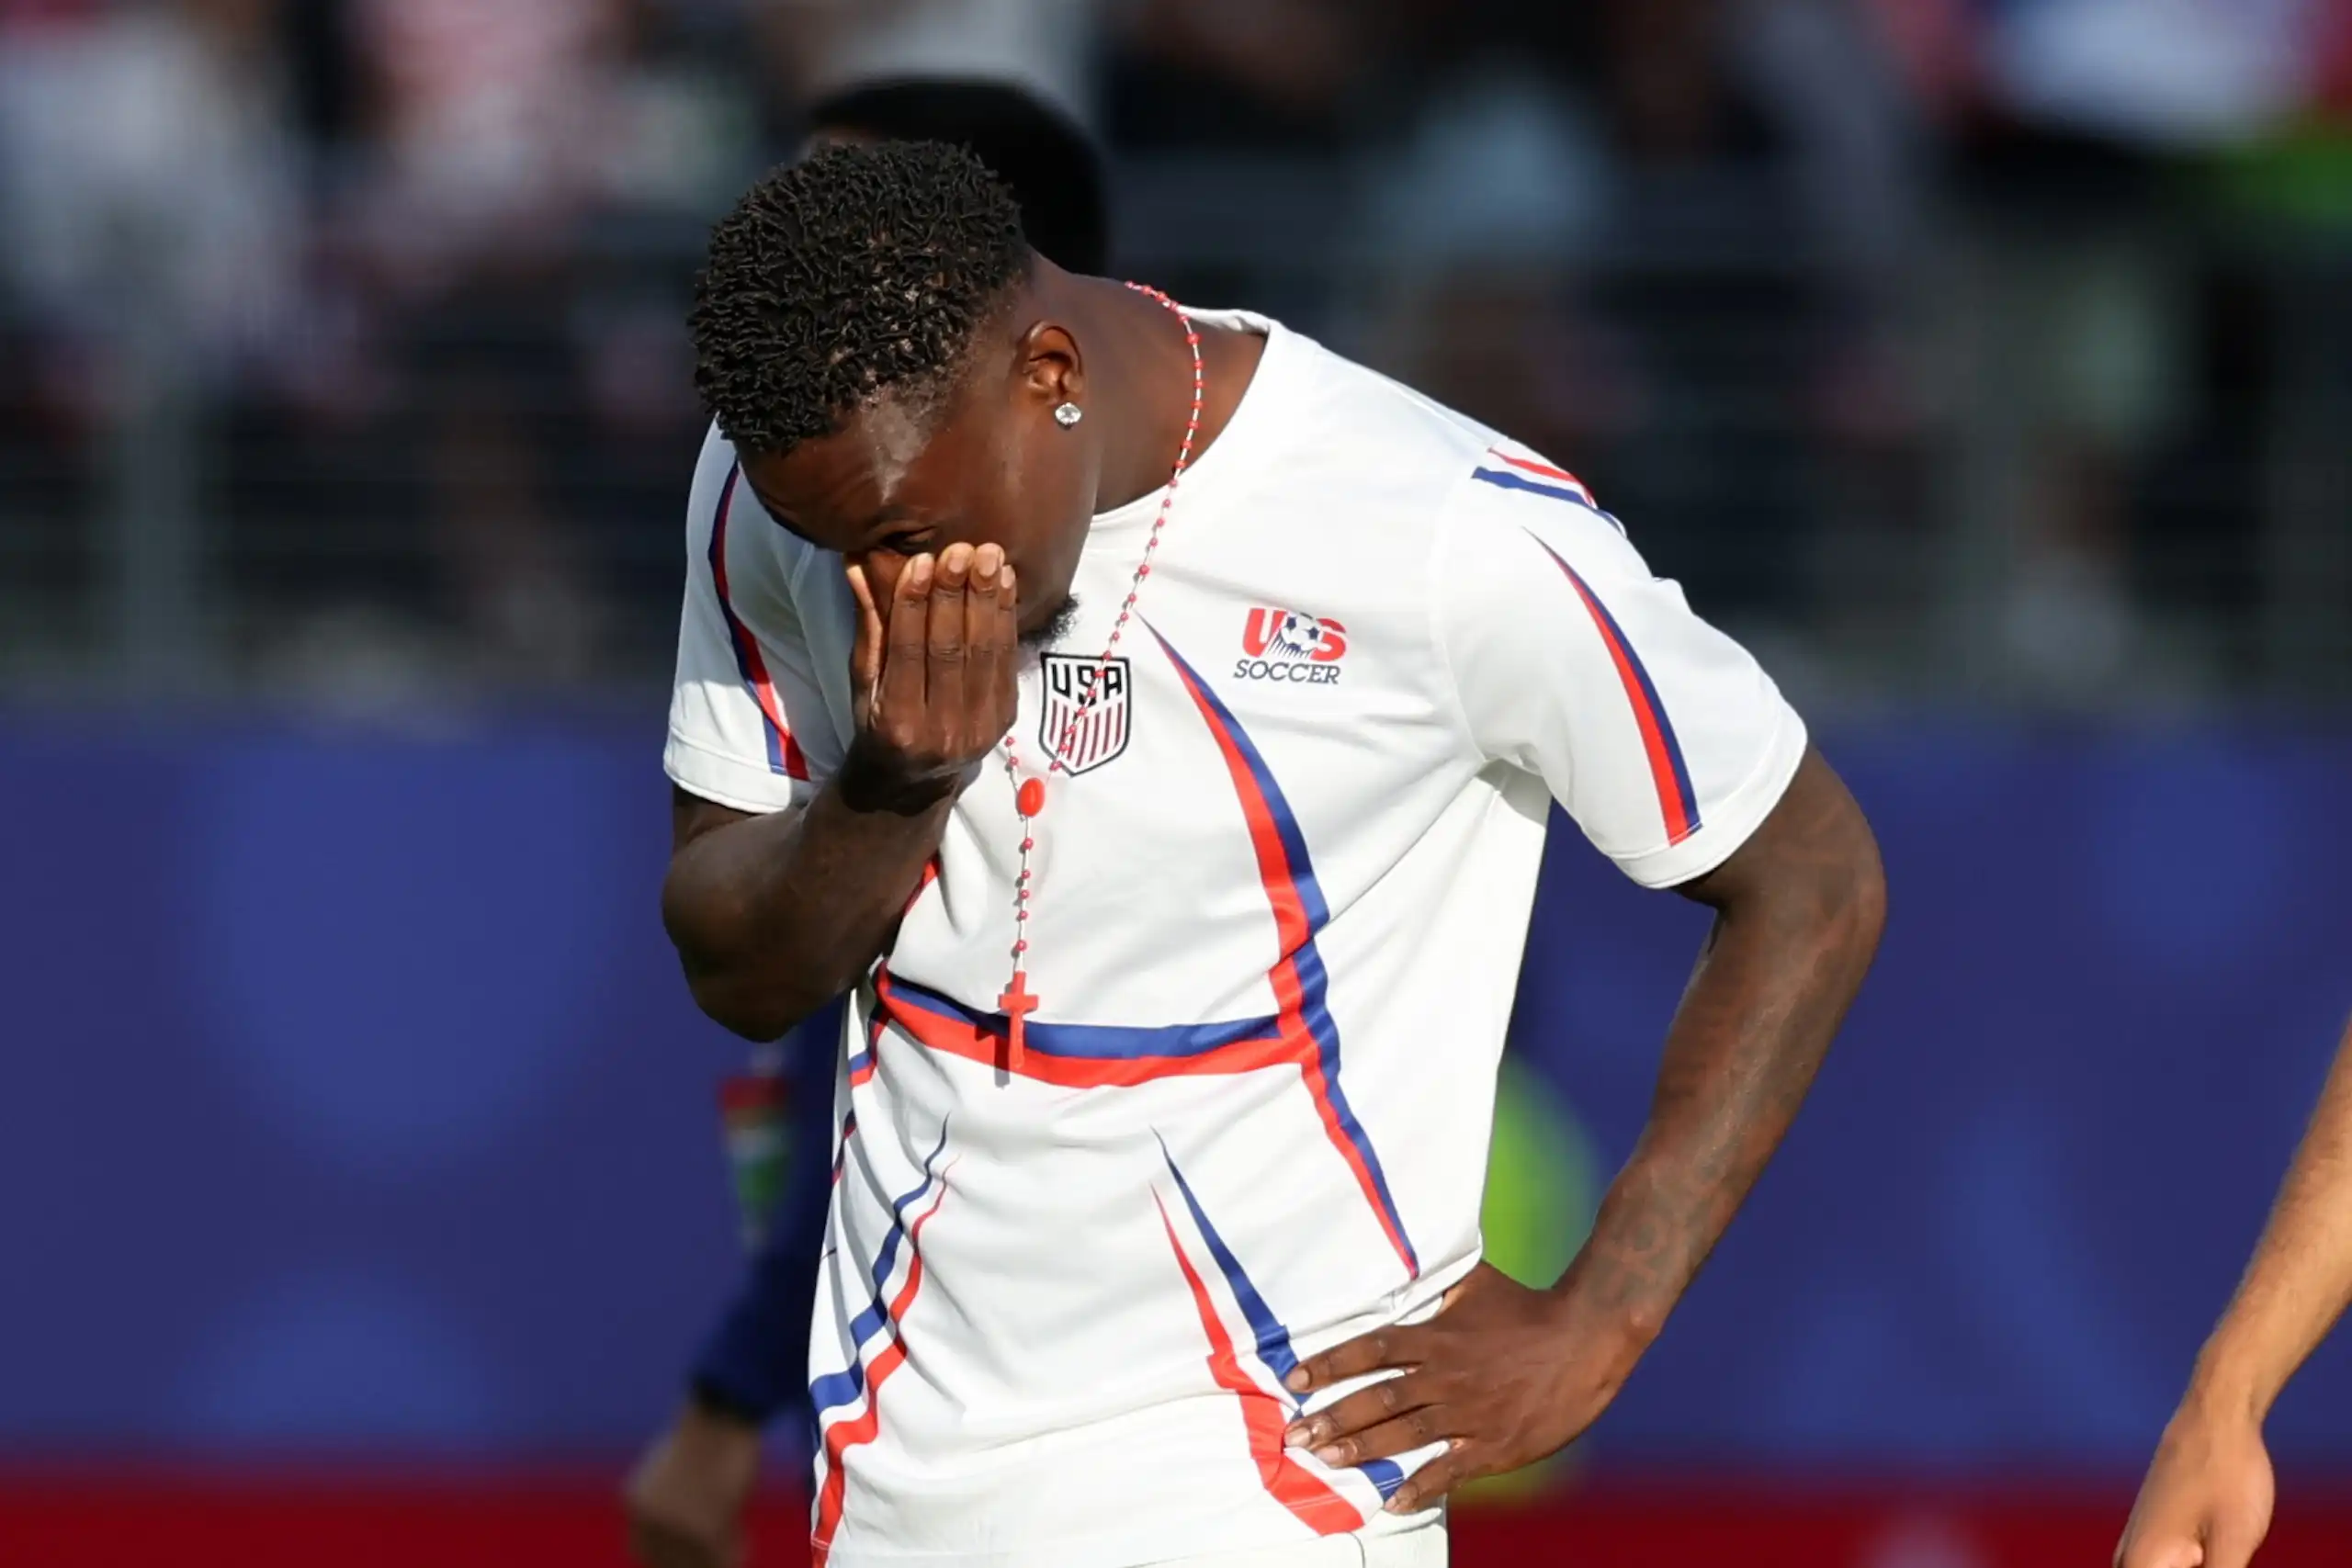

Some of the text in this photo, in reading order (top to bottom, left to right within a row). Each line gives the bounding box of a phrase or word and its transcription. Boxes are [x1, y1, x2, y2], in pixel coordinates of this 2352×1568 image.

[1242, 607, 1348, 661] US
[1051, 663, 1123, 705] USA
[1234, 660, 1340, 684] SOCCER
